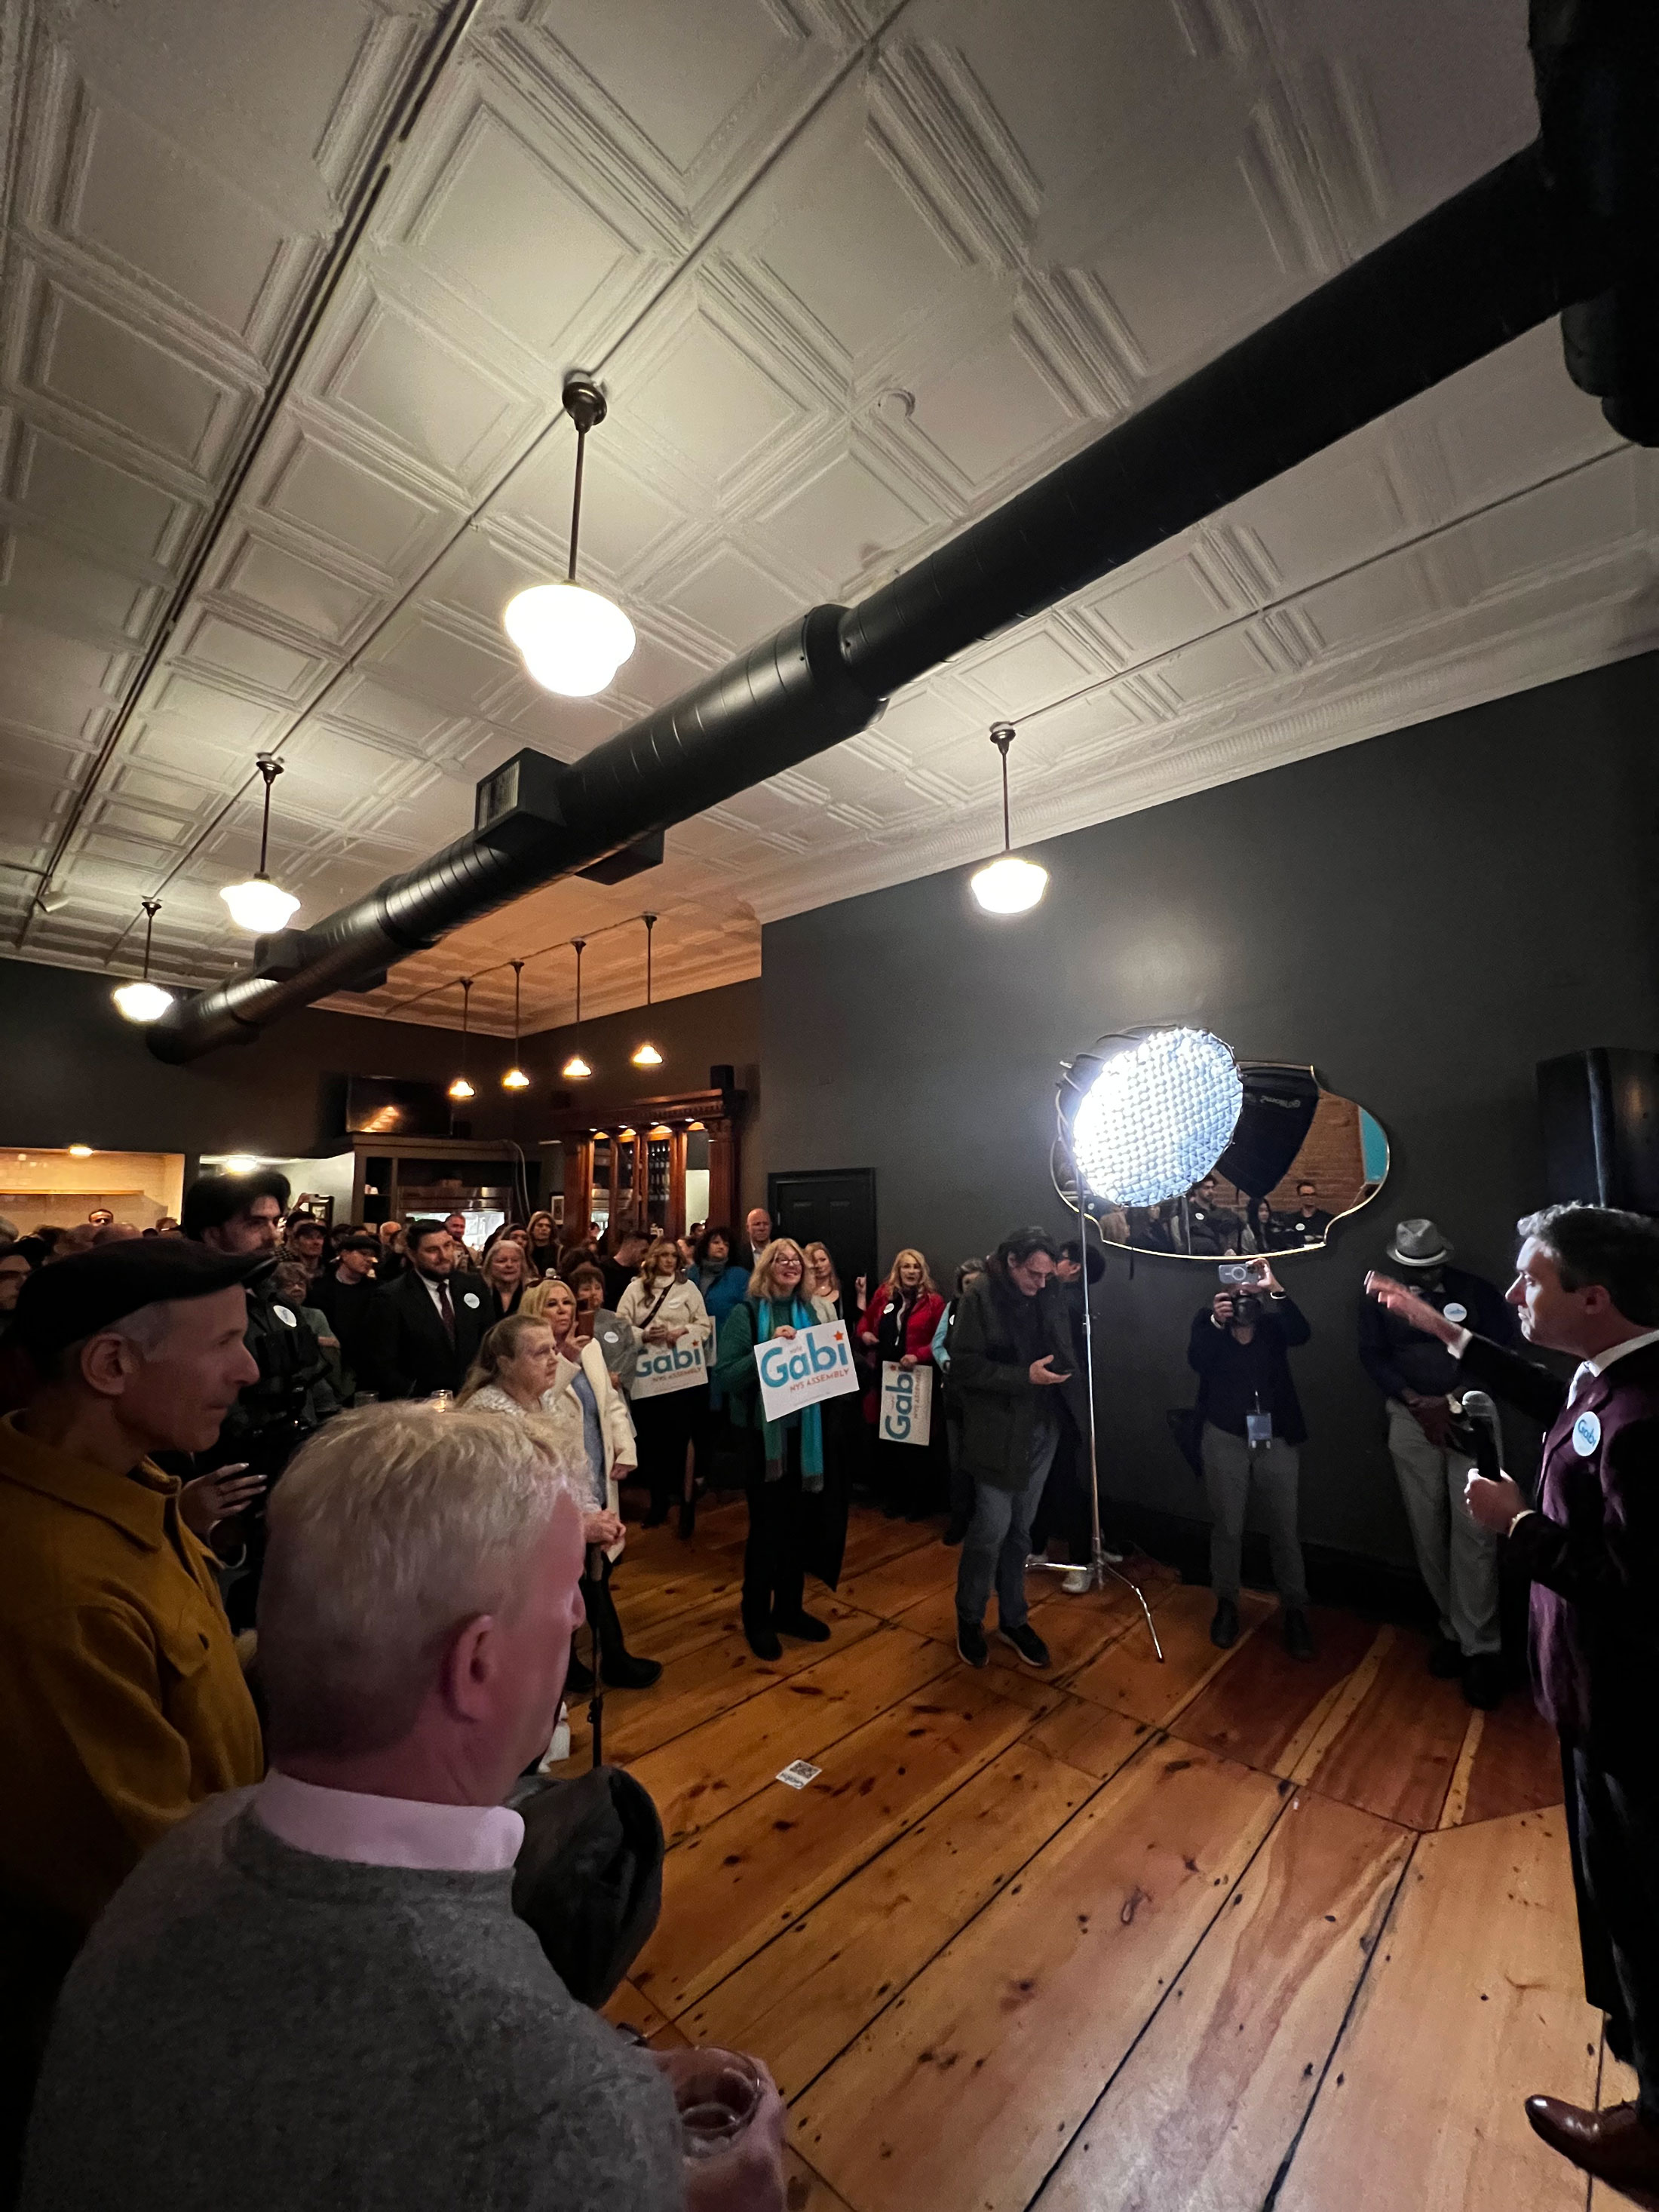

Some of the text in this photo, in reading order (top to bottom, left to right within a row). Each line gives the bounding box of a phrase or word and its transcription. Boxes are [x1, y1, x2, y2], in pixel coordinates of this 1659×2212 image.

[635, 1340, 701, 1377] Gabi
[761, 1331, 848, 1388] Gabi
[790, 1368, 849, 1392] NYS ASSEMBLY
[1578, 1419, 1596, 1447] Gabi
